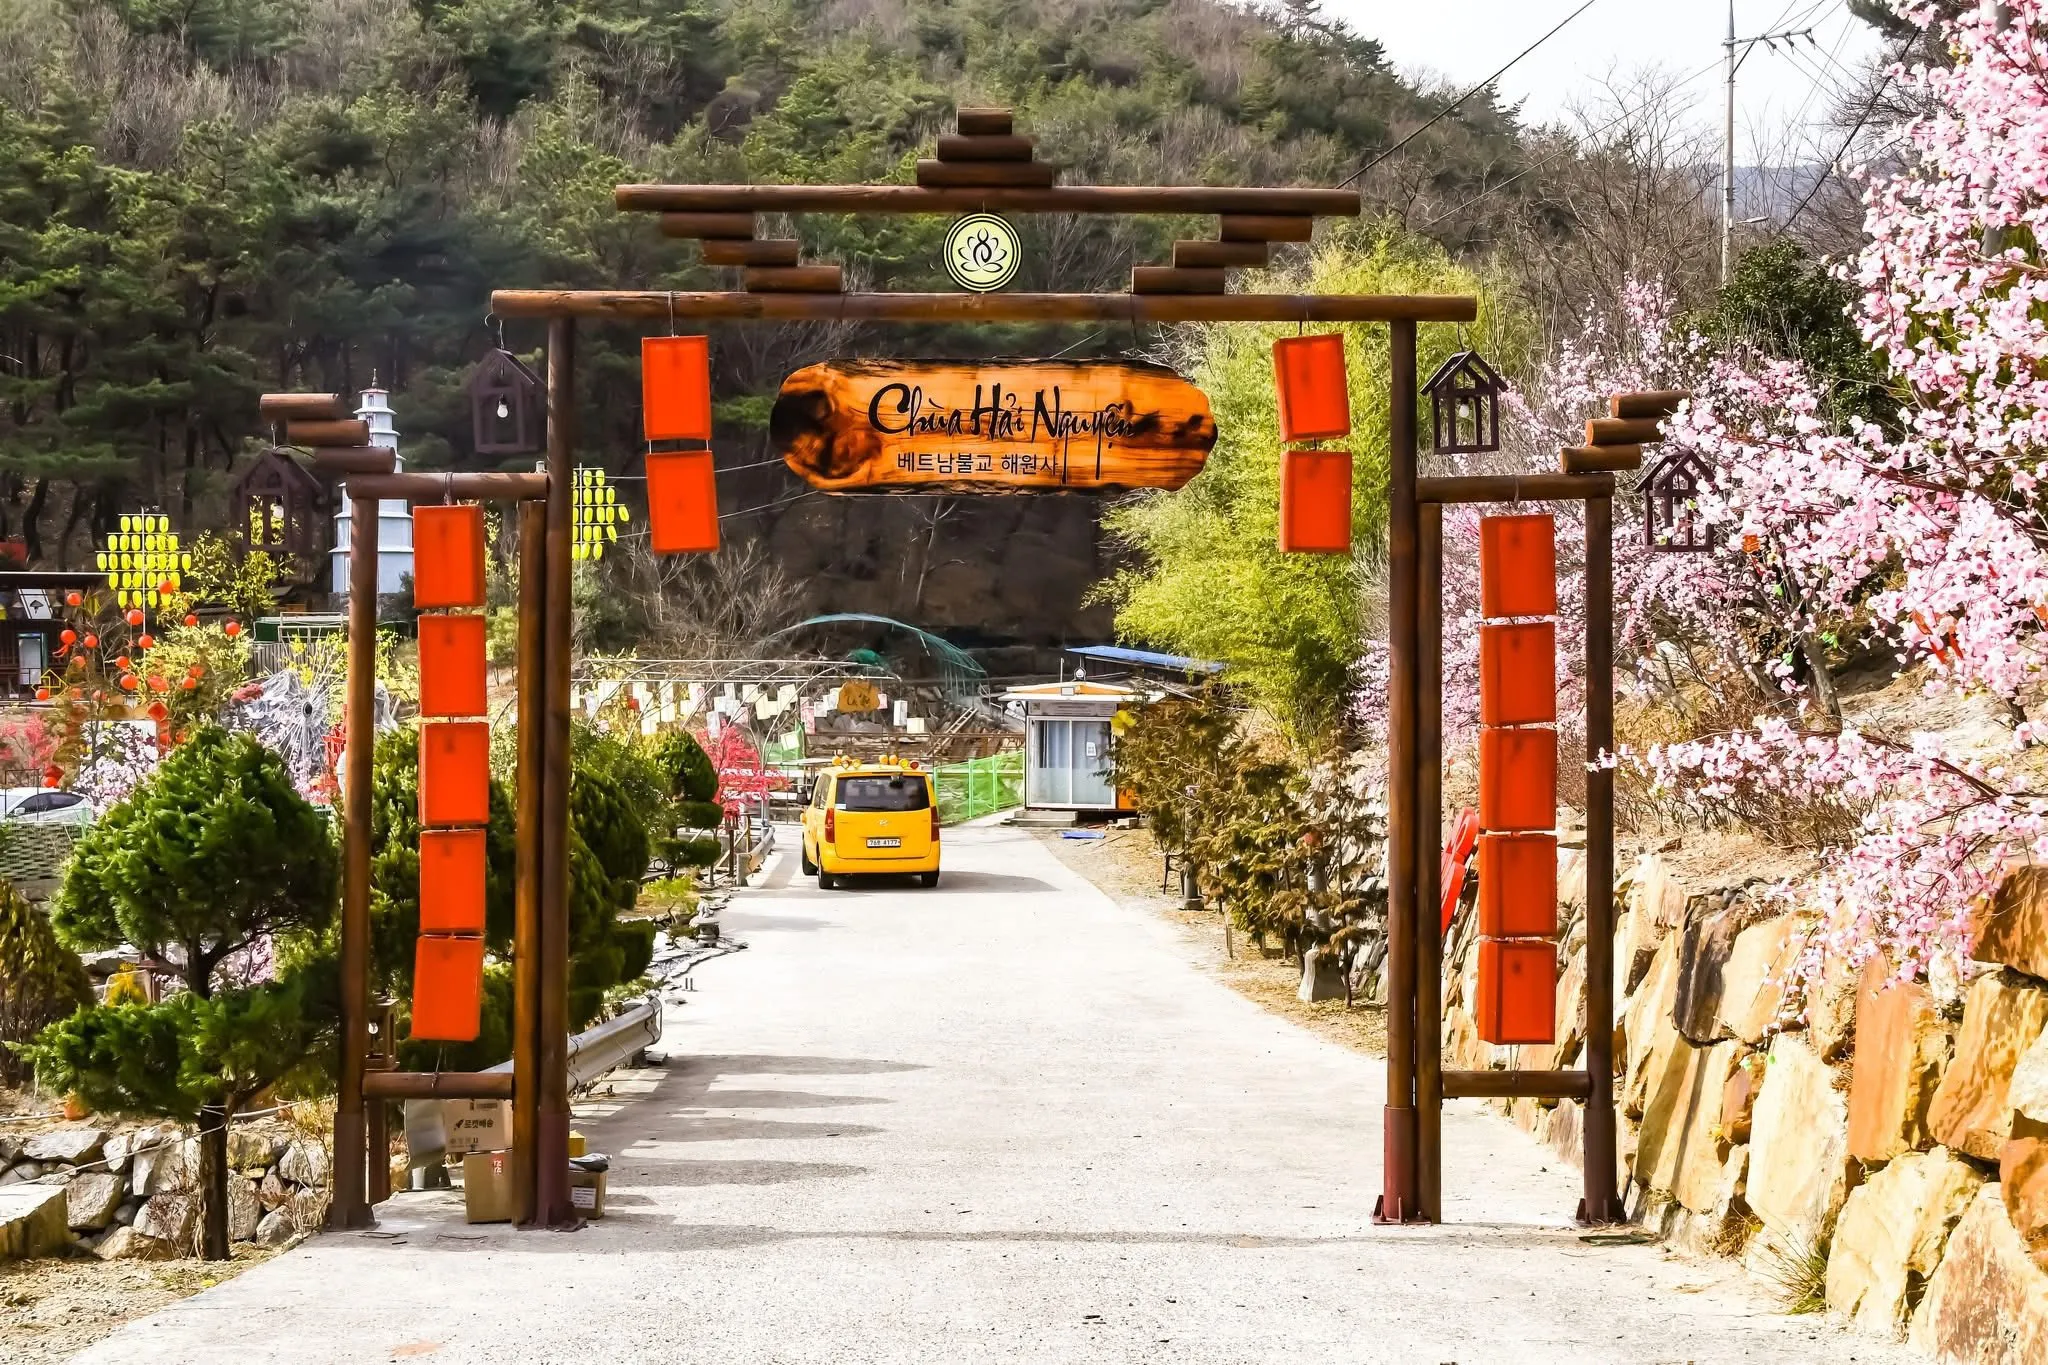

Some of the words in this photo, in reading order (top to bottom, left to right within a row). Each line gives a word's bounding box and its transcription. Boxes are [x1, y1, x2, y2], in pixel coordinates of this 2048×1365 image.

[868, 382, 963, 437] Chùa
[970, 382, 1025, 442] Hải
[1031, 385, 1137, 484] Nguyện
[897, 451, 993, 474] 베트남불교
[1001, 452, 1061, 476] 해원사
